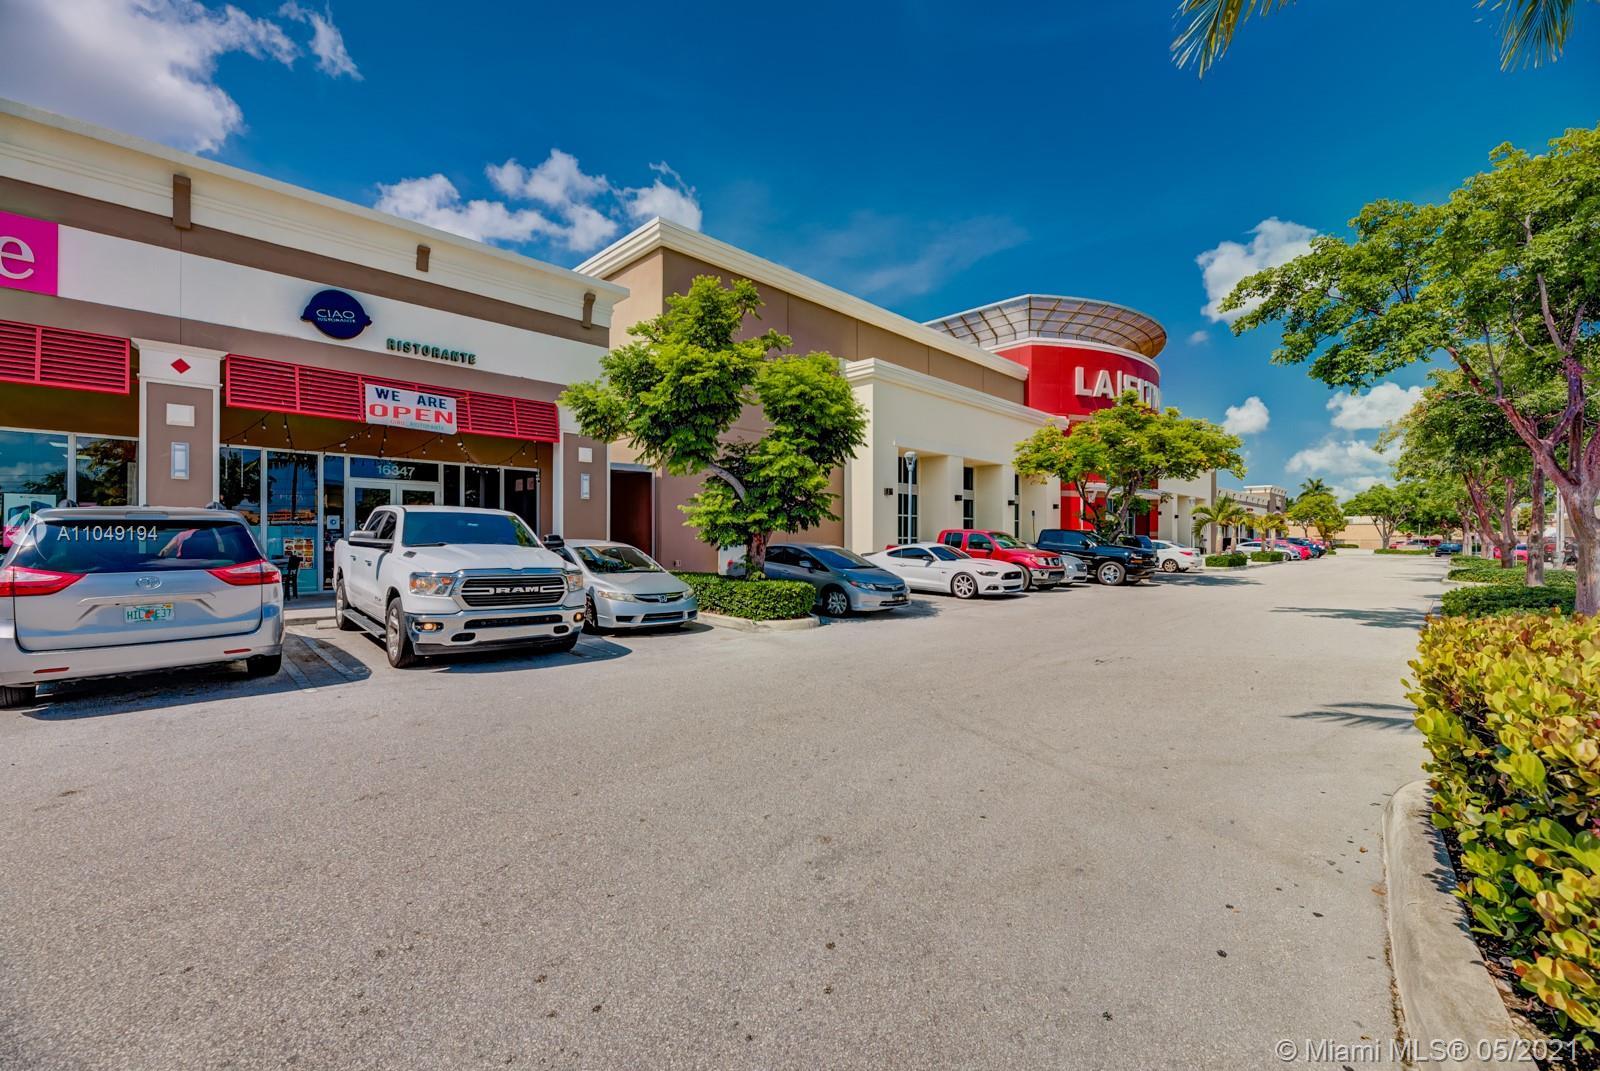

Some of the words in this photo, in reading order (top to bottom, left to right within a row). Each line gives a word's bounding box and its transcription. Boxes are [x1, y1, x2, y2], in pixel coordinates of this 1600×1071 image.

[316, 308, 355, 319] CIAO
[386, 337, 476, 365] RISTORANTE
[375, 387, 401, 402] WE
[417, 395, 448, 410] ARE
[369, 403, 453, 424] OPEN
[377, 464, 415, 478] 16347
[496, 586, 539, 594] RAM
